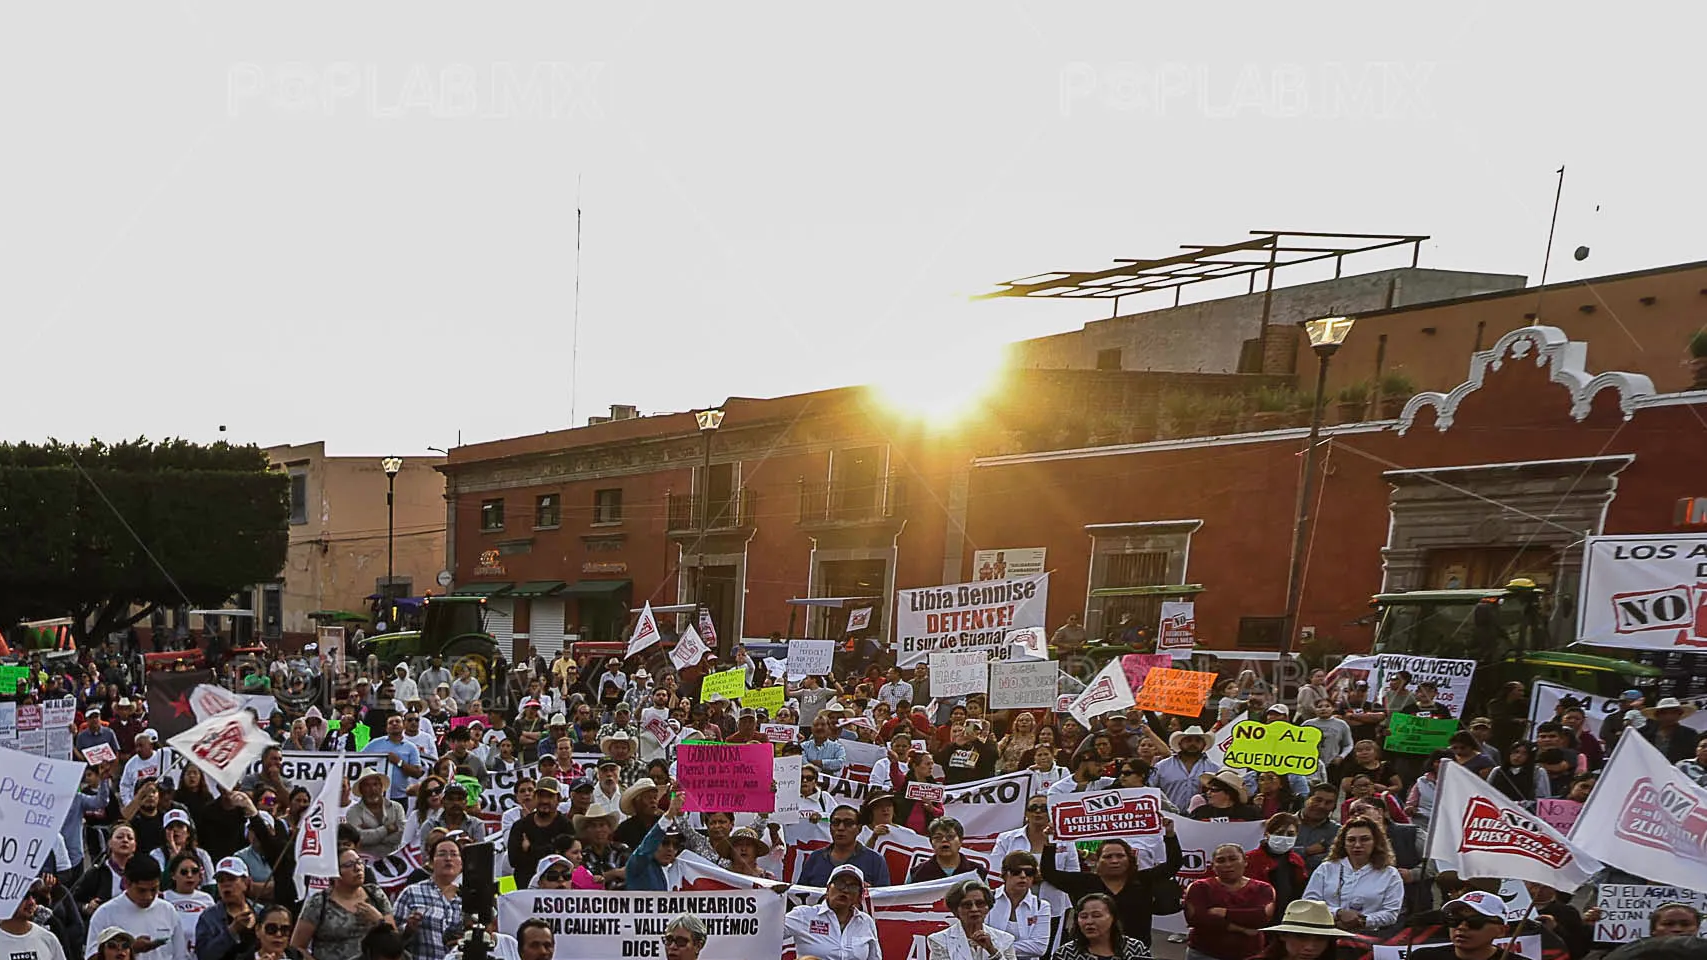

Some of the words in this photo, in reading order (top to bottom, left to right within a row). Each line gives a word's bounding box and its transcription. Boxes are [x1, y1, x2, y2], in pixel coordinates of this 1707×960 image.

[1615, 543, 1678, 560] LOS
[911, 587, 953, 612] Libia
[958, 580, 1036, 608] Dennise
[926, 605, 1014, 634] DETENTE!
[1619, 594, 1687, 627] NO
[904, 637, 914, 651] El
[916, 637, 937, 652] sur
[939, 634, 958, 650] de
[1374, 656, 1411, 671] JENNY
[1412, 659, 1472, 677] OLIVEROS
[1236, 726, 1266, 743] NO
[1279, 729, 1308, 744] AL
[1224, 751, 1318, 771] ACUEDUCTO
[33, 763, 54, 785] EL
[1087, 793, 1122, 812] NO
[1135, 802, 1151, 811] AL
[1063, 812, 1134, 826] ACUEDUCTO
[1068, 821, 1111, 833] PRESA
[1113, 819, 1148, 831] SOLIS
[1468, 830, 1511, 846] PRESA
[24, 838, 44, 870] AL
[1602, 885, 1617, 898] SI
[1623, 886, 1639, 898] EL
[1644, 887, 1679, 900] AGUA
[532, 897, 630, 914] ASOCIACION
[633, 897, 653, 914] DE
[656, 896, 757, 914] BALNEARIOS
[1600, 898, 1610, 909] A
[563, 918, 621, 935] CALIENTE
[1597, 924, 1628, 941] NO
[622, 941, 660, 958] DICE
